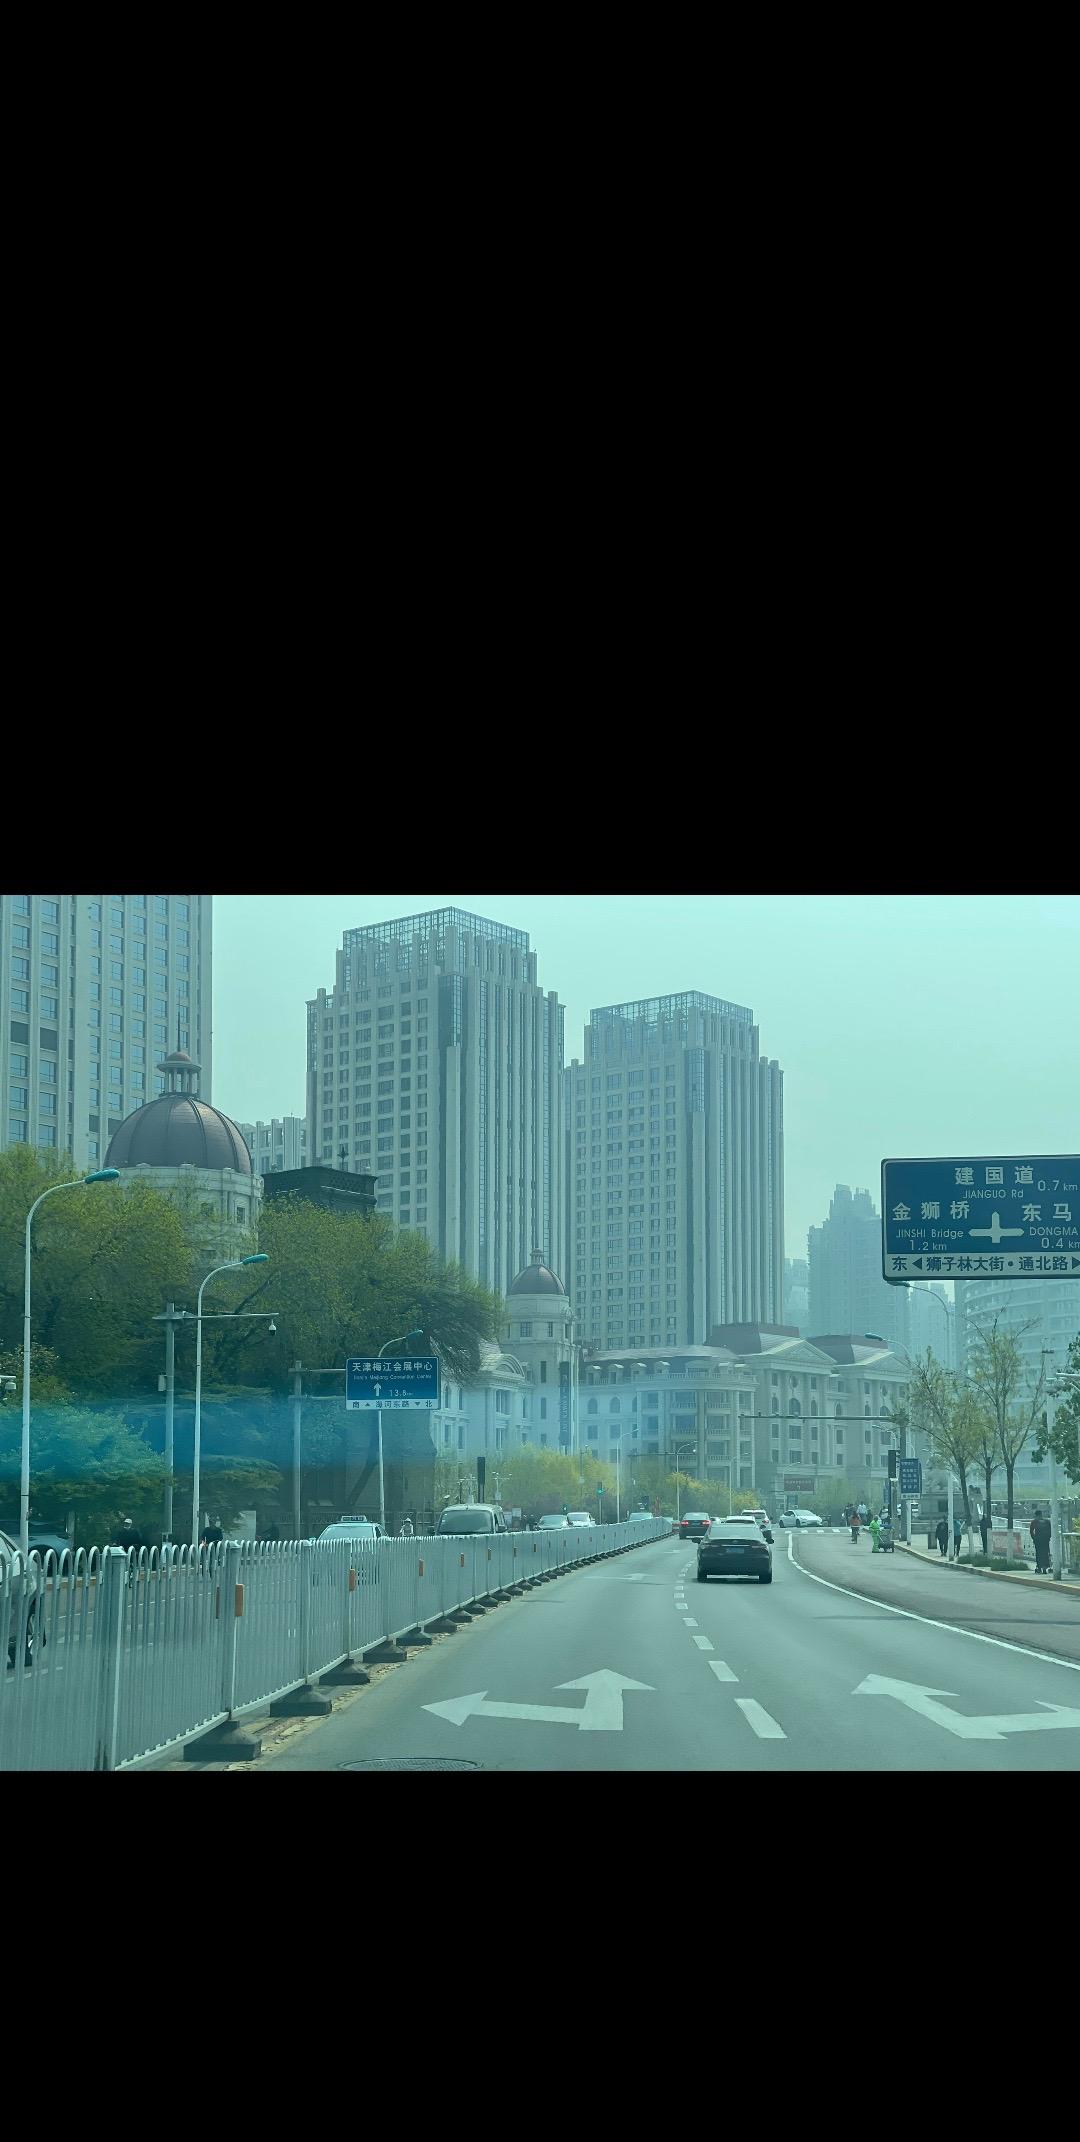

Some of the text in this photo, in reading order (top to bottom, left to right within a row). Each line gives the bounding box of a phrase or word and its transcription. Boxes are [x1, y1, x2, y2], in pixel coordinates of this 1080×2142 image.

[954, 1165, 1034, 1186] 建国道
[1038, 1180, 1078, 1191] 0.7 km
[963, 1189, 1024, 1199] JIANGUO Rd
[892, 1200, 970, 1221] 金狮桥
[1021, 1203, 1072, 1222] 东马
[896, 1228, 964, 1240] JINSHI Bridge
[1029, 1227, 1078, 1236] DONGMA
[909, 1240, 947, 1251] 1.2 km
[1041, 1237, 1063, 1249] 0.4
[892, 1256, 908, 1271] 东
[352, 1361, 433, 1372] 天津梅江会展中心
